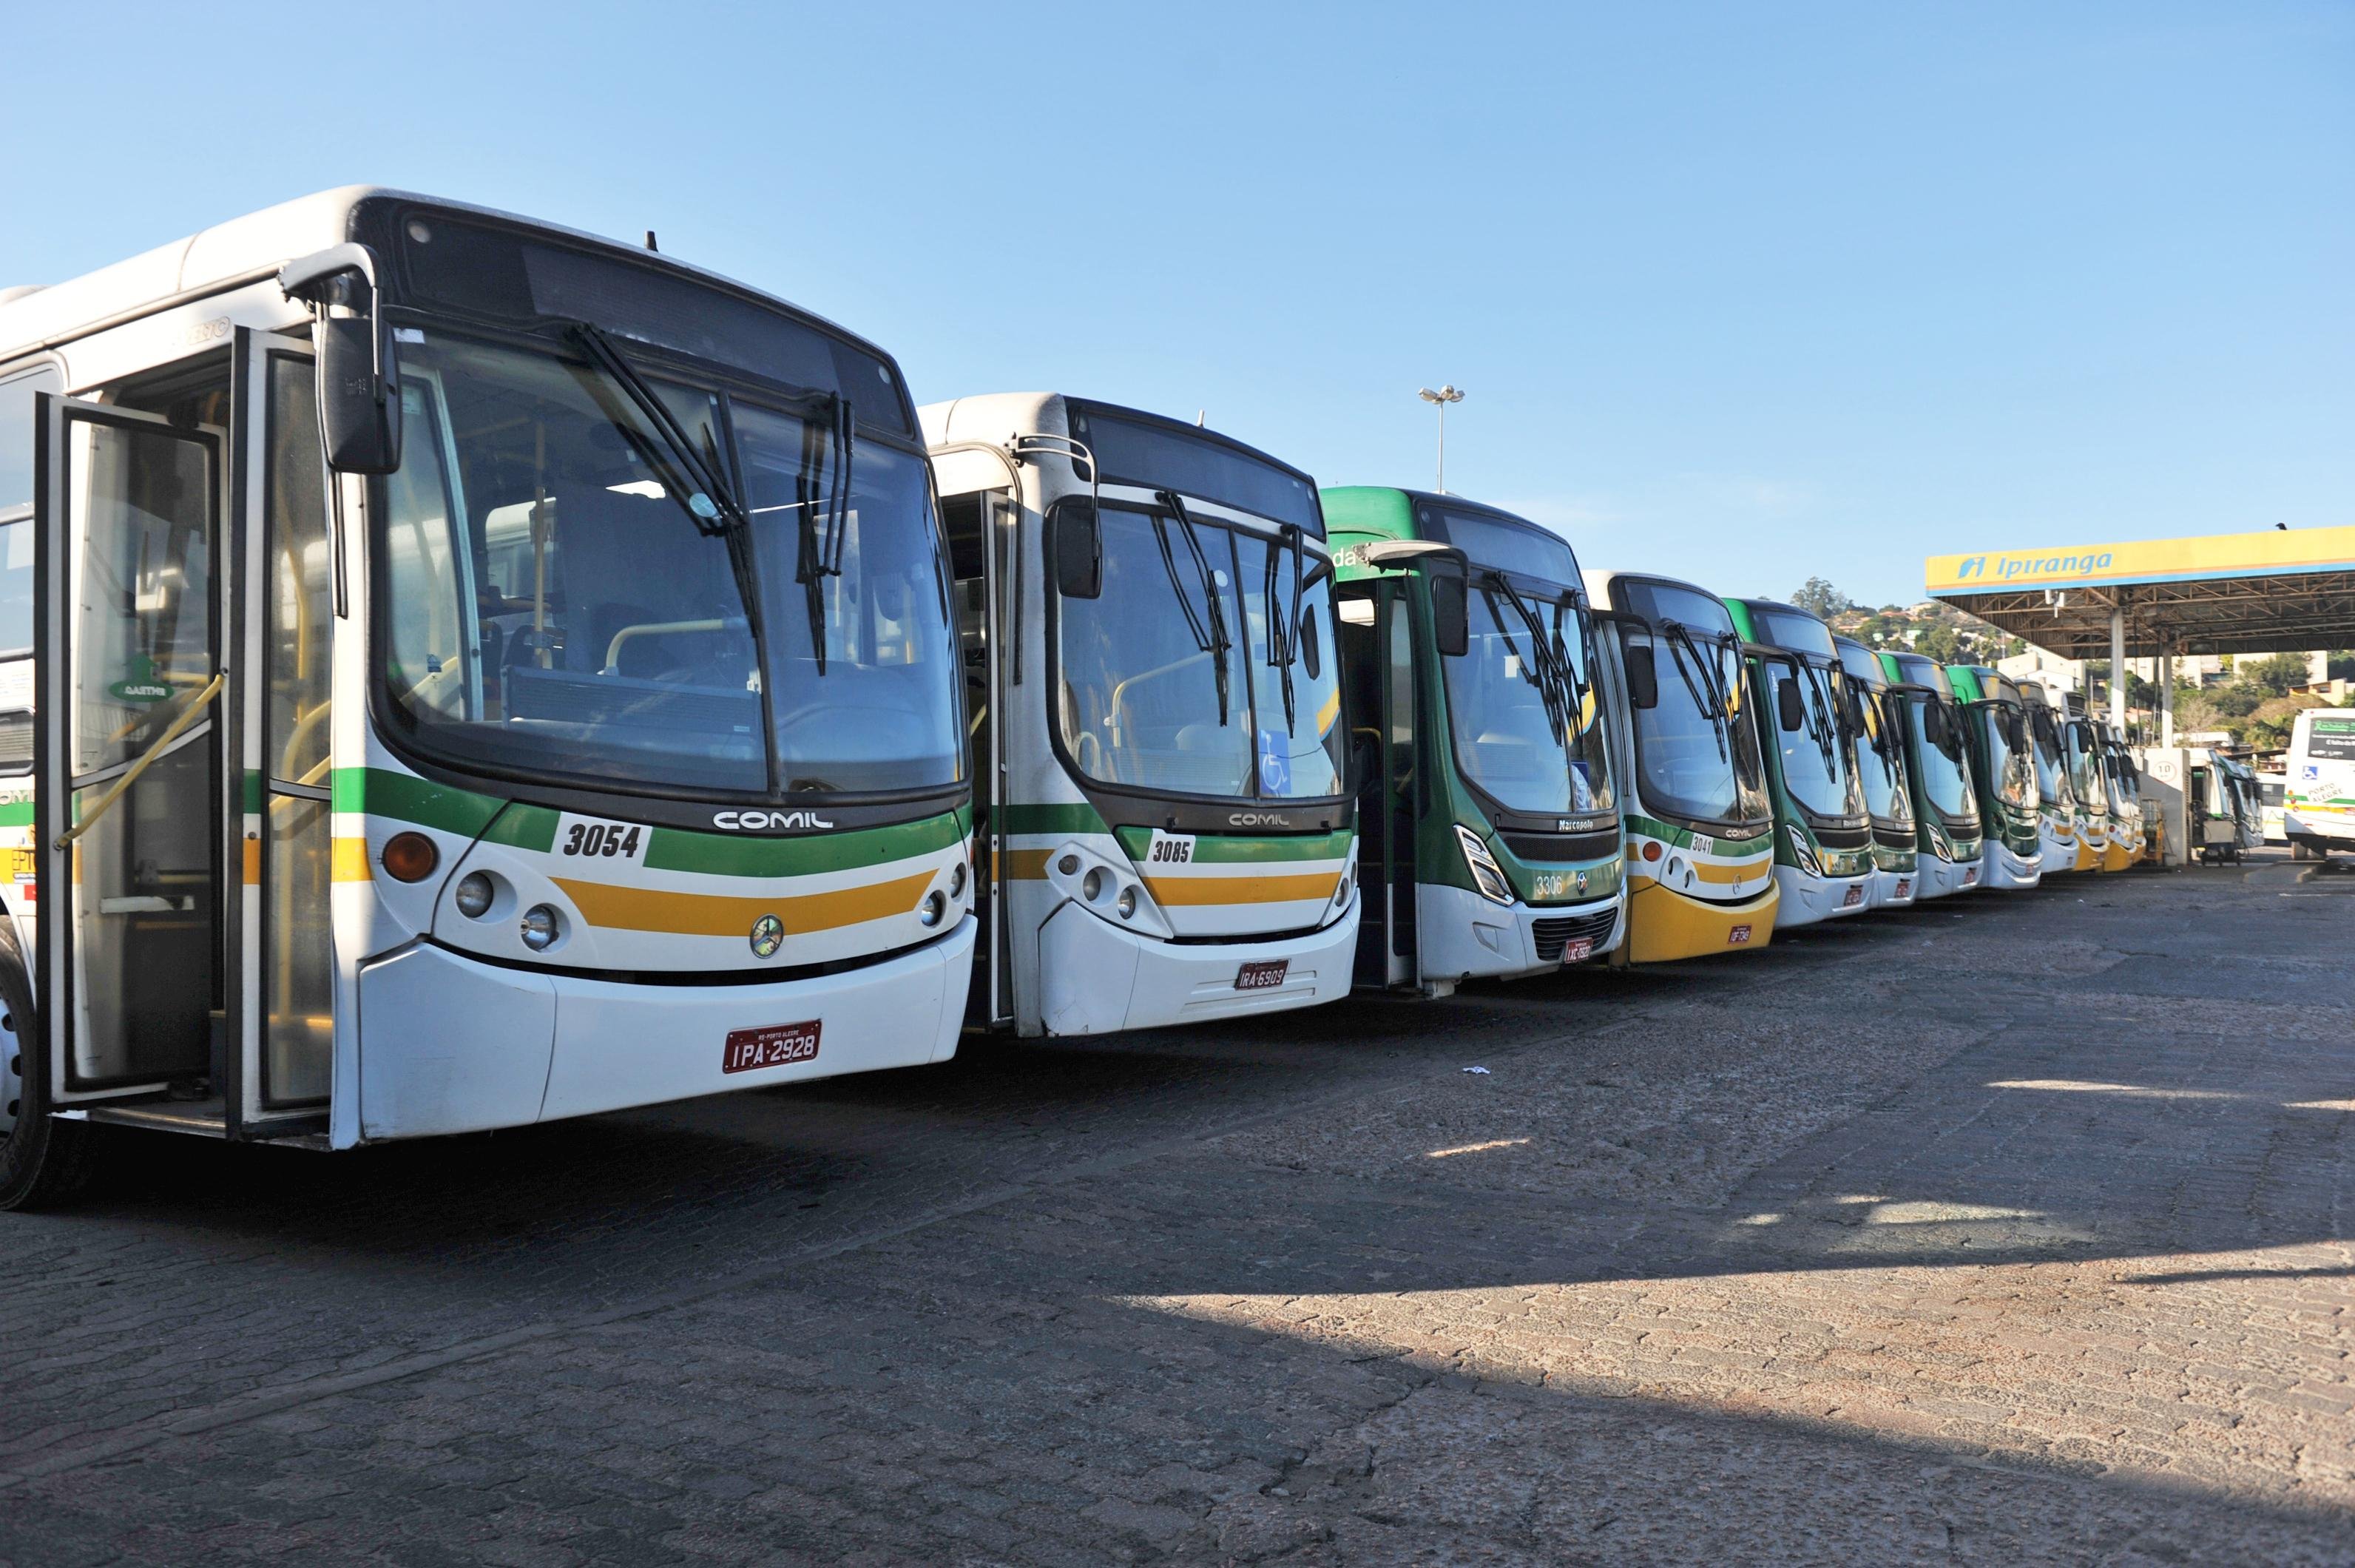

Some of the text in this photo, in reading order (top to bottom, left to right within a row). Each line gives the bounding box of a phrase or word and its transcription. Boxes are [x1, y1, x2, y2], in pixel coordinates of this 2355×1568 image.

[1997, 553, 2113, 579] Ipiranga
[2158, 765, 2171, 773] 10
[2308, 783, 2336, 797] PORTO
[2313, 788, 2344, 803] ALEGRE
[713, 811, 834, 830] COMIL
[1229, 813, 1290, 826] COMIL
[1558, 819, 1594, 831] Marcopolo
[563, 823, 641, 858] 3054
[1725, 829, 1752, 837] COMIL
[1152, 840, 1190, 862] 3085
[1692, 836, 1712, 854] 3041
[1536, 875, 1562, 895] 3306
